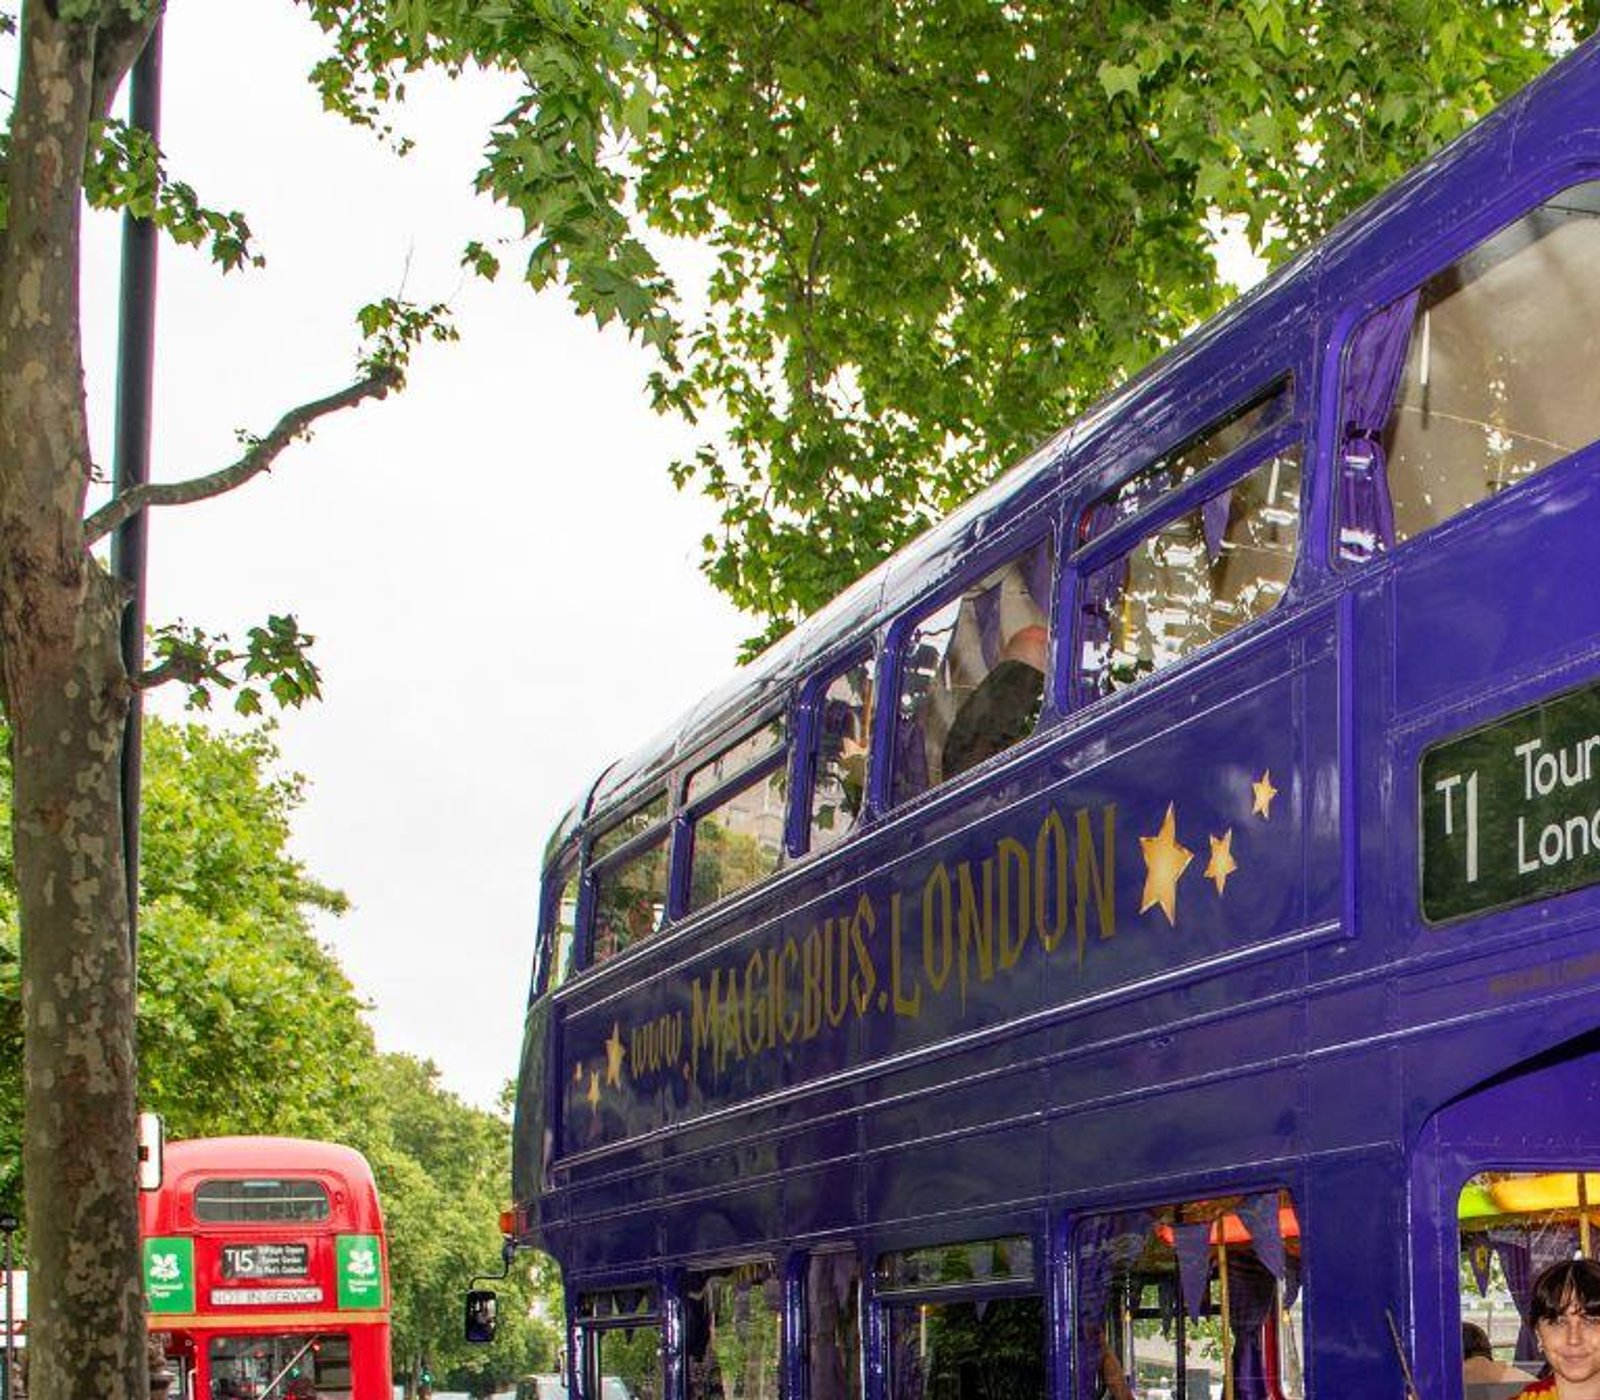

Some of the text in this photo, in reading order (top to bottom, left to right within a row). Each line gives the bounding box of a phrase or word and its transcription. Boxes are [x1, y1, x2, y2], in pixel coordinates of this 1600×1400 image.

[1514, 735, 1600, 801] Tour
[1435, 769, 1478, 883] T1
[224, 1248, 256, 1272] T15
